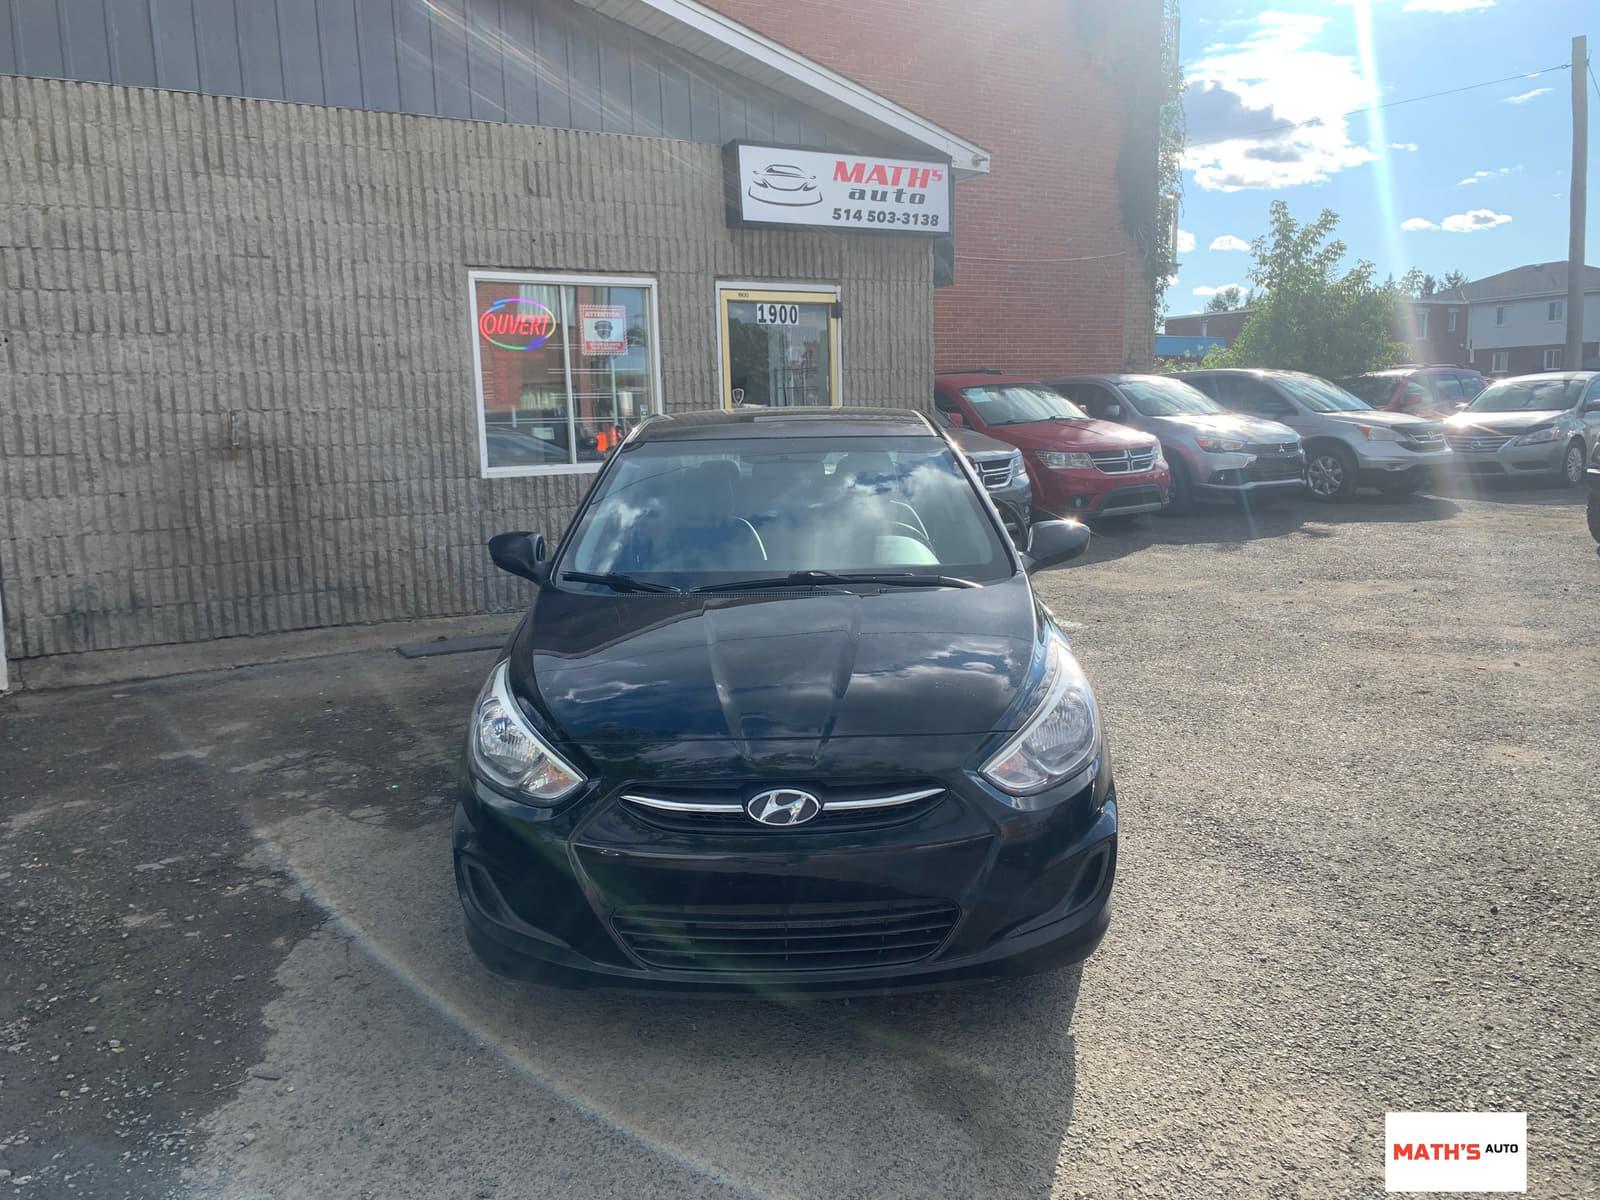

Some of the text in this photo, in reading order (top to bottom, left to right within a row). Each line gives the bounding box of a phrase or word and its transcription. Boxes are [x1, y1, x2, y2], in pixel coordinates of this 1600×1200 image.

[848, 187, 926, 205] auto
[832, 208, 939, 227] 514 503-3138
[758, 304, 798, 323] 1900
[484, 313, 550, 335] OUVERT
